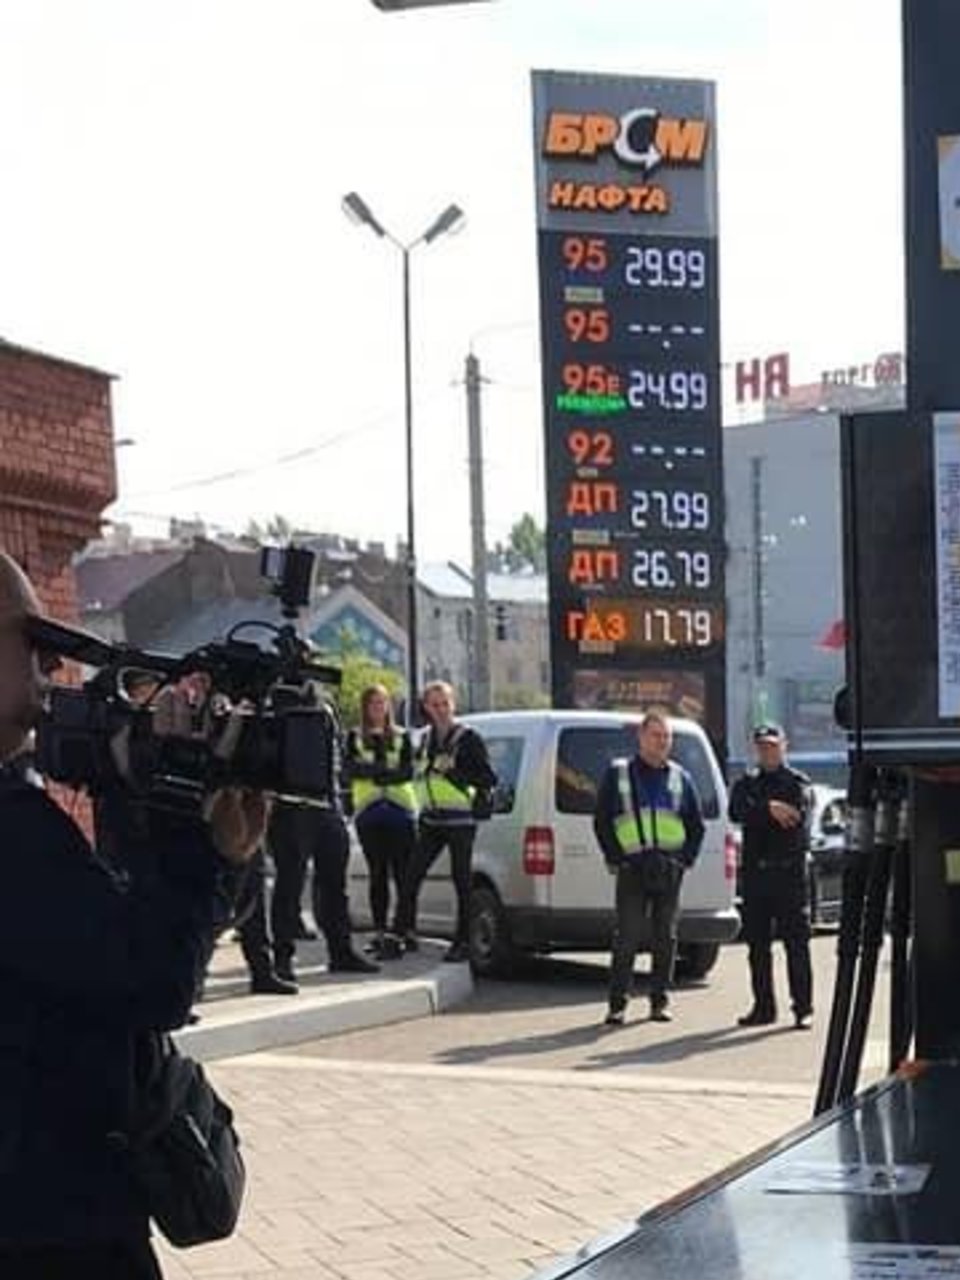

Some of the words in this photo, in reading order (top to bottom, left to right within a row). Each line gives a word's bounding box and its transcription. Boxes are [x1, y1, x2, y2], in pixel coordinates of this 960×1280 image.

[549, 181, 669, 212] НАФТА
[562, 239, 608, 271] 95
[626, 247, 705, 288] 29.99
[564, 310, 610, 342] 95
[628, 370, 707, 409] 24.99
[568, 431, 613, 464] 92
[567, 483, 618, 516] ДП
[631, 491, 709, 528] 27.99
[569, 551, 619, 583] ДП
[632, 550, 710, 588] 26.79
[567, 611, 628, 641] ГАЗ
[644, 610, 710, 645] 17.79
